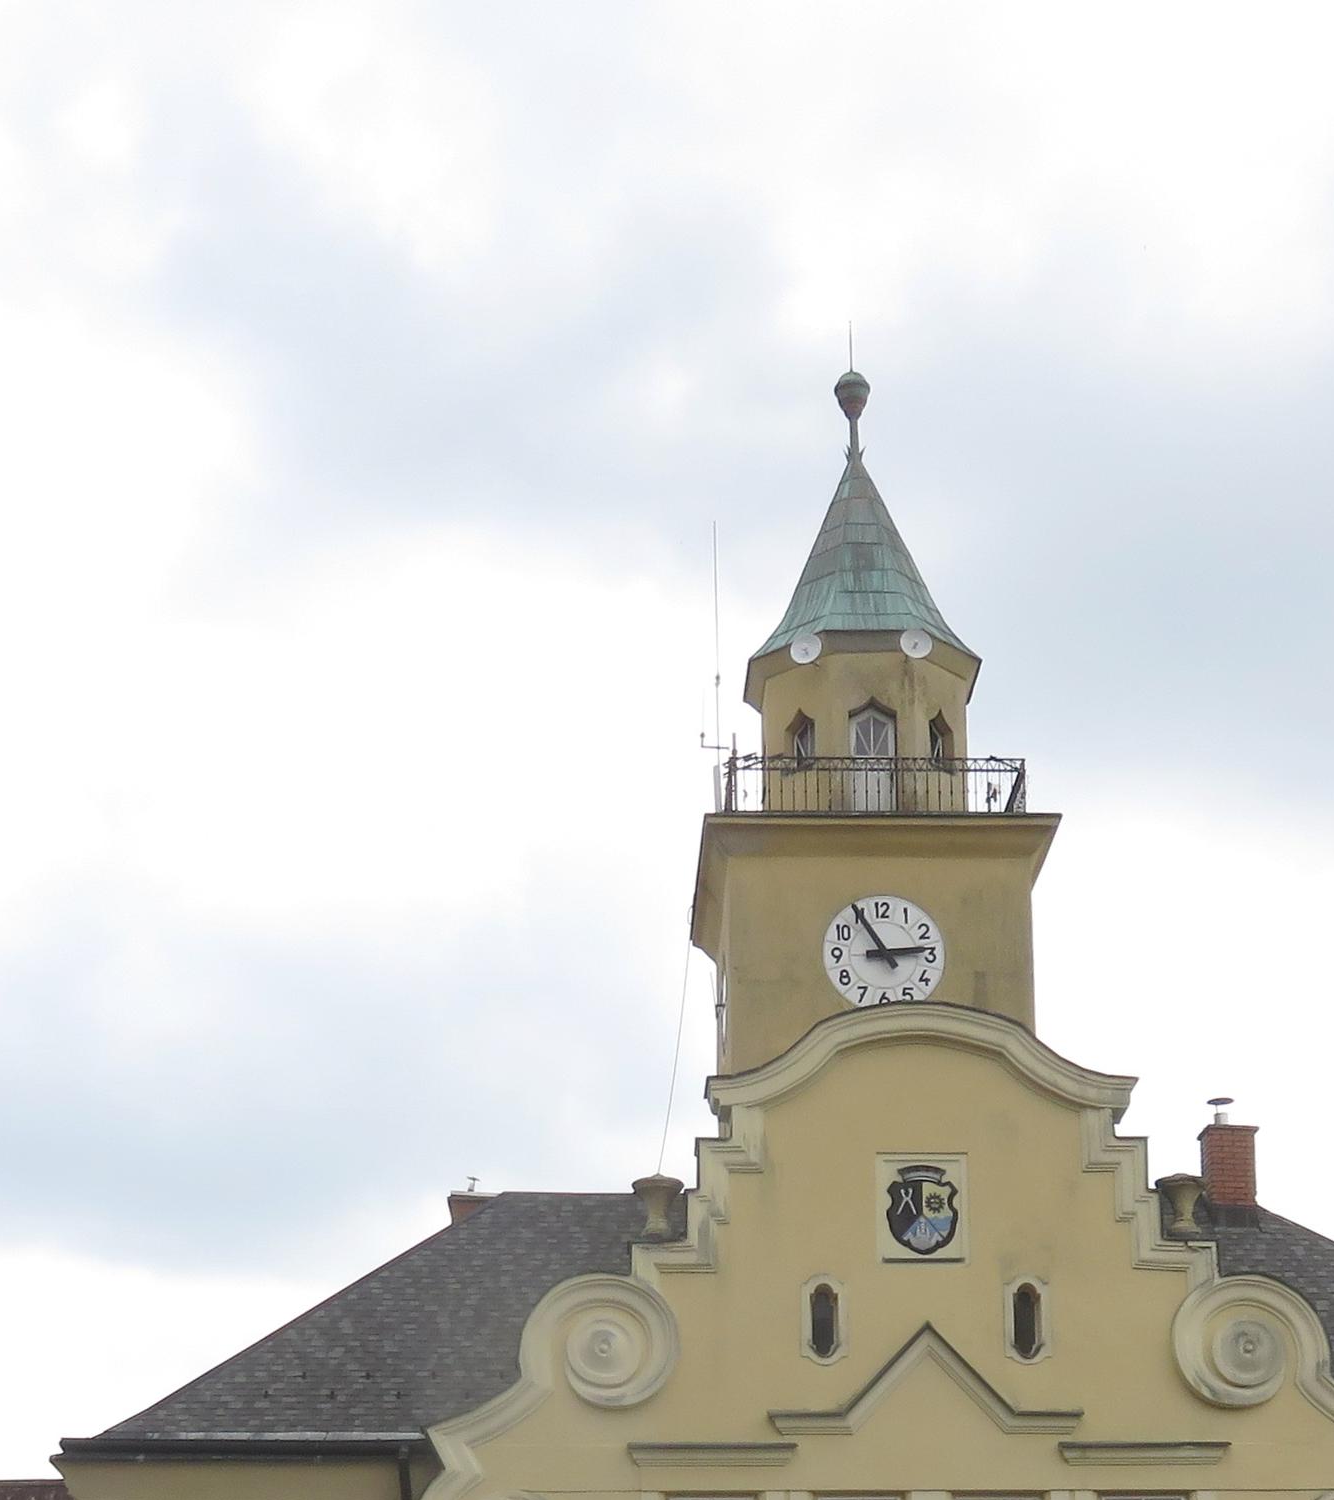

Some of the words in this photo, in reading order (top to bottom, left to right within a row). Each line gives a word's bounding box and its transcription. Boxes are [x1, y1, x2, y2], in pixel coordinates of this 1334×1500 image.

[874, 901, 890, 919] 12
[902, 907, 909, 924] 1
[836, 924, 851, 941] 10
[917, 923, 931, 940] 2
[831, 946, 843, 964] 9
[924, 947, 937, 963] 3
[839, 969, 851, 986] 8
[918, 969, 931, 986] 4
[857, 986, 868, 1003] 7
[878, 992, 891, 1004] 6
[901, 987, 914, 1000] 5
